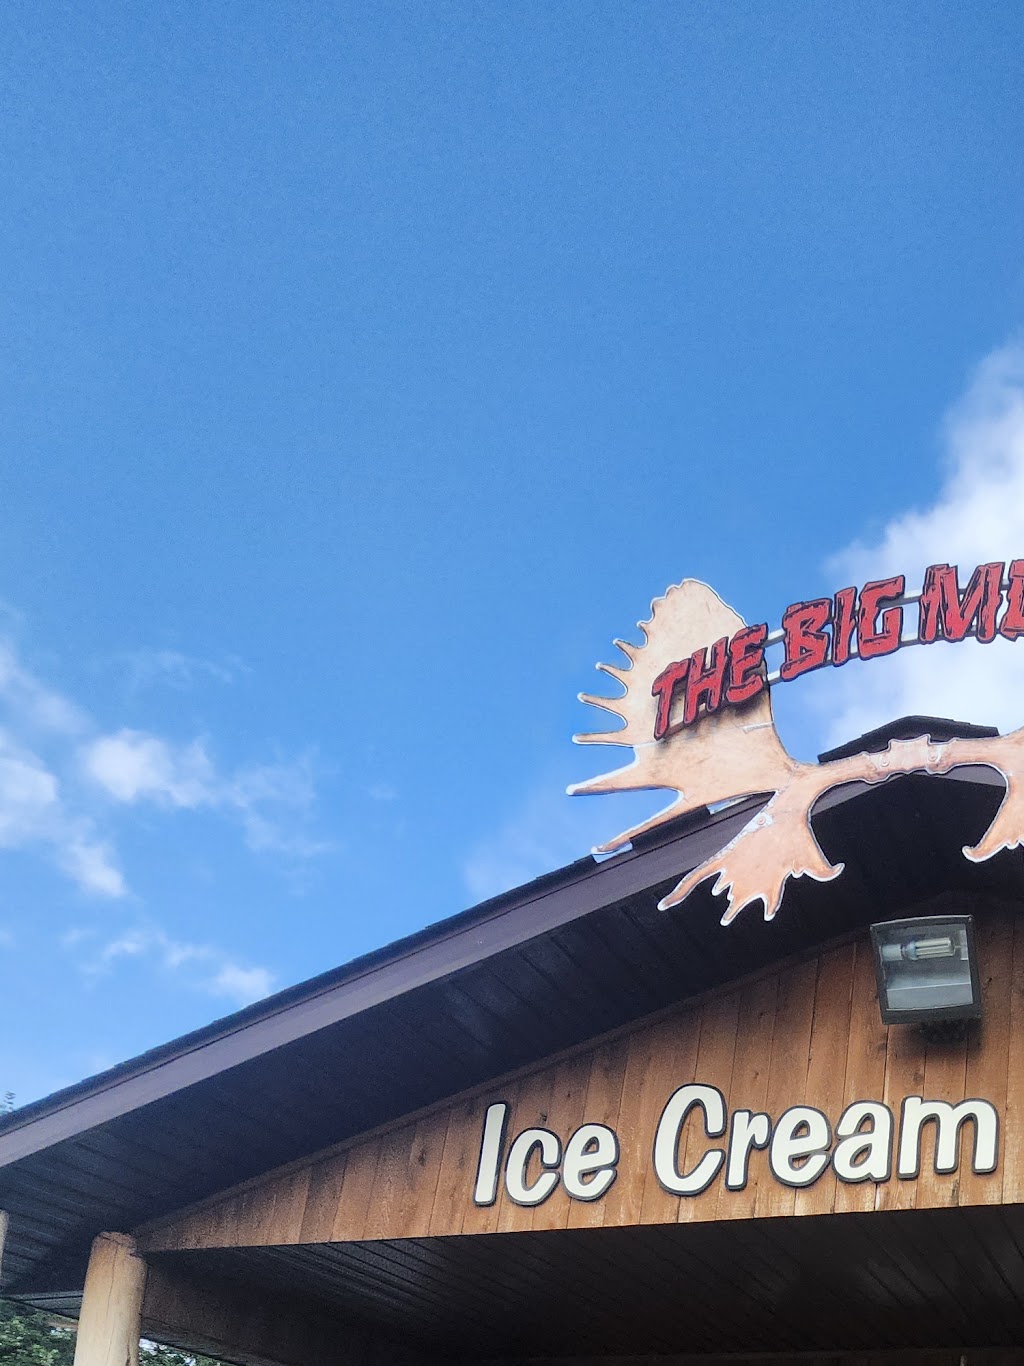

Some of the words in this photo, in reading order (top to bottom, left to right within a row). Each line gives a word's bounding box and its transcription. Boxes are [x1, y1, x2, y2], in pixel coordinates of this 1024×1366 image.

[651, 623, 769, 740] THE
[780, 575, 906, 681] BIG
[473, 1099, 620, 1209] Ice
[651, 1082, 1001, 1198] Cream
